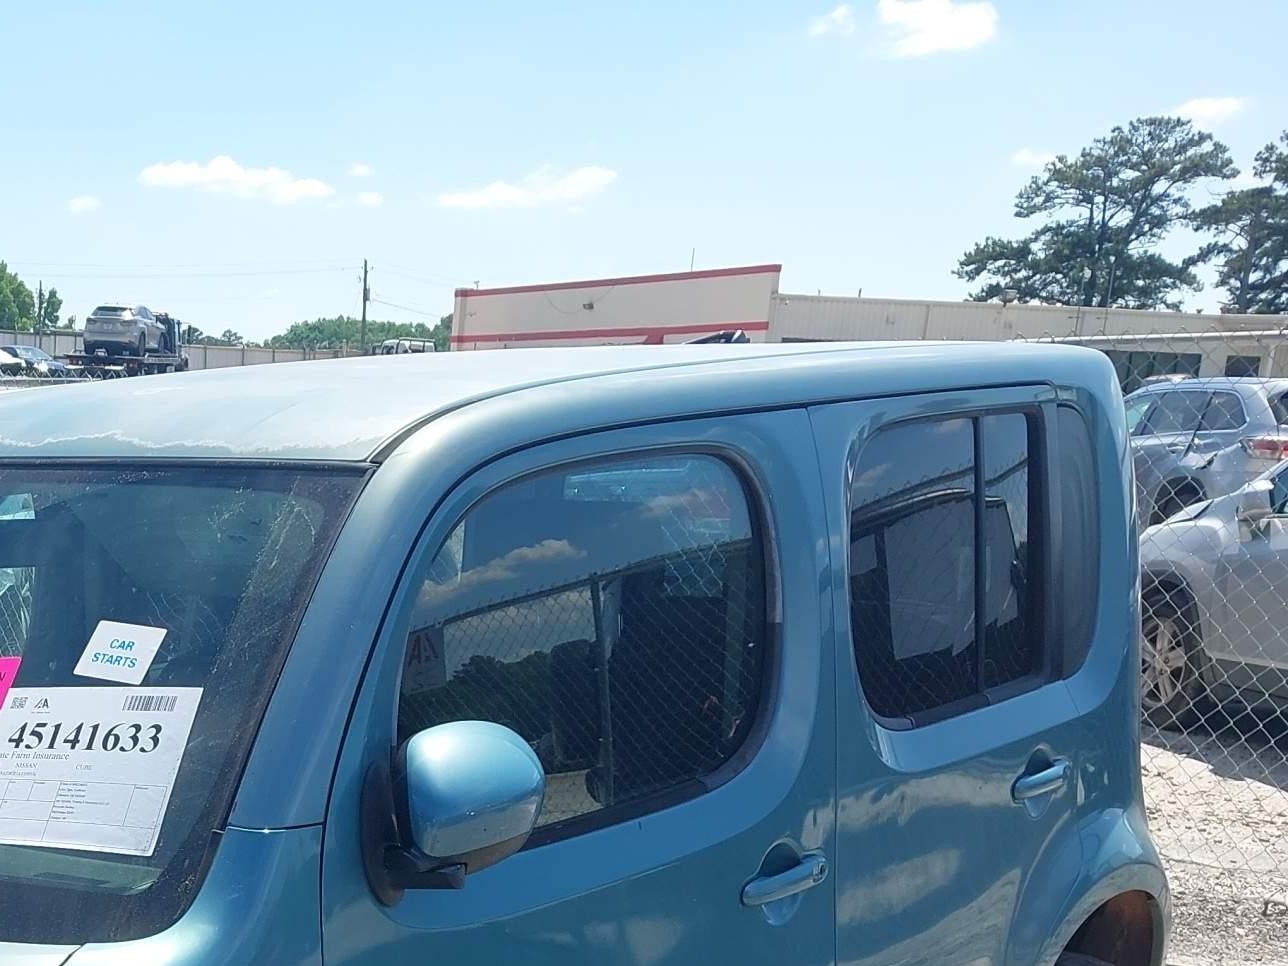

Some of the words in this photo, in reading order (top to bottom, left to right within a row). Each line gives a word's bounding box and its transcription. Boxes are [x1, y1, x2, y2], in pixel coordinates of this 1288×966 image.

[109, 638, 136, 652] CAR
[91, 652, 138, 669] STARTS
[7, 721, 163, 754] 45141633
[11, 751, 31, 760] Farm
[32, 751, 71, 761] Insurance
